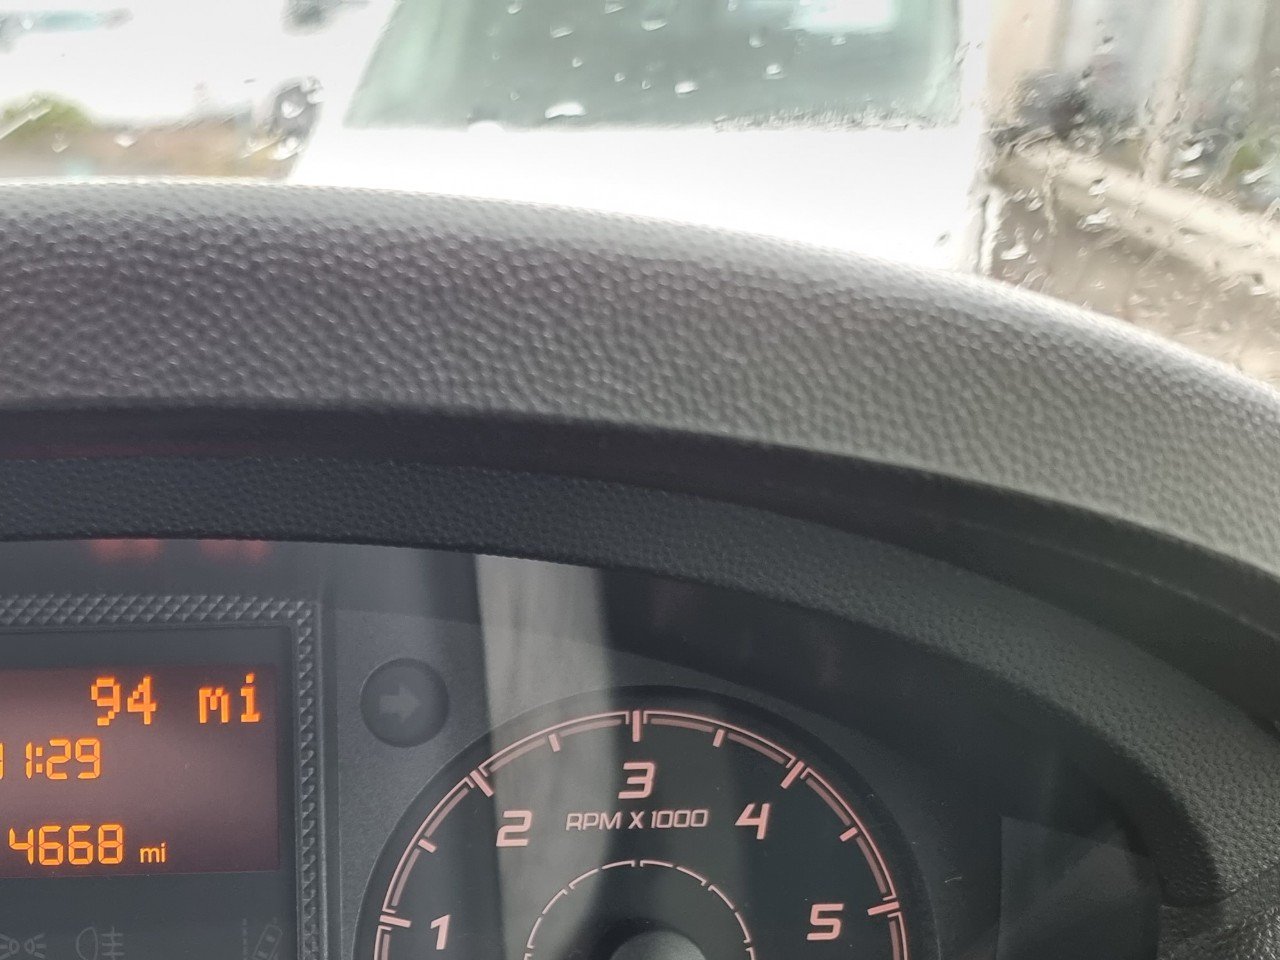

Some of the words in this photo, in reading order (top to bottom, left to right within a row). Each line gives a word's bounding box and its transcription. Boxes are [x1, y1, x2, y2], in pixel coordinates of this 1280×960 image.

[90, 675, 156, 726] 94
[198, 673, 261, 724] mi
[618, 762, 655, 799] 3
[496, 810, 532, 847] 2
[565, 813, 620, 830] RPM
[651, 809, 709, 828] 1000
[735, 803, 770, 839] 4
[8, 824, 123, 866] 4668
[140, 843, 166, 863] mi
[430, 915, 450, 950] 1
[807, 903, 844, 940] 5
